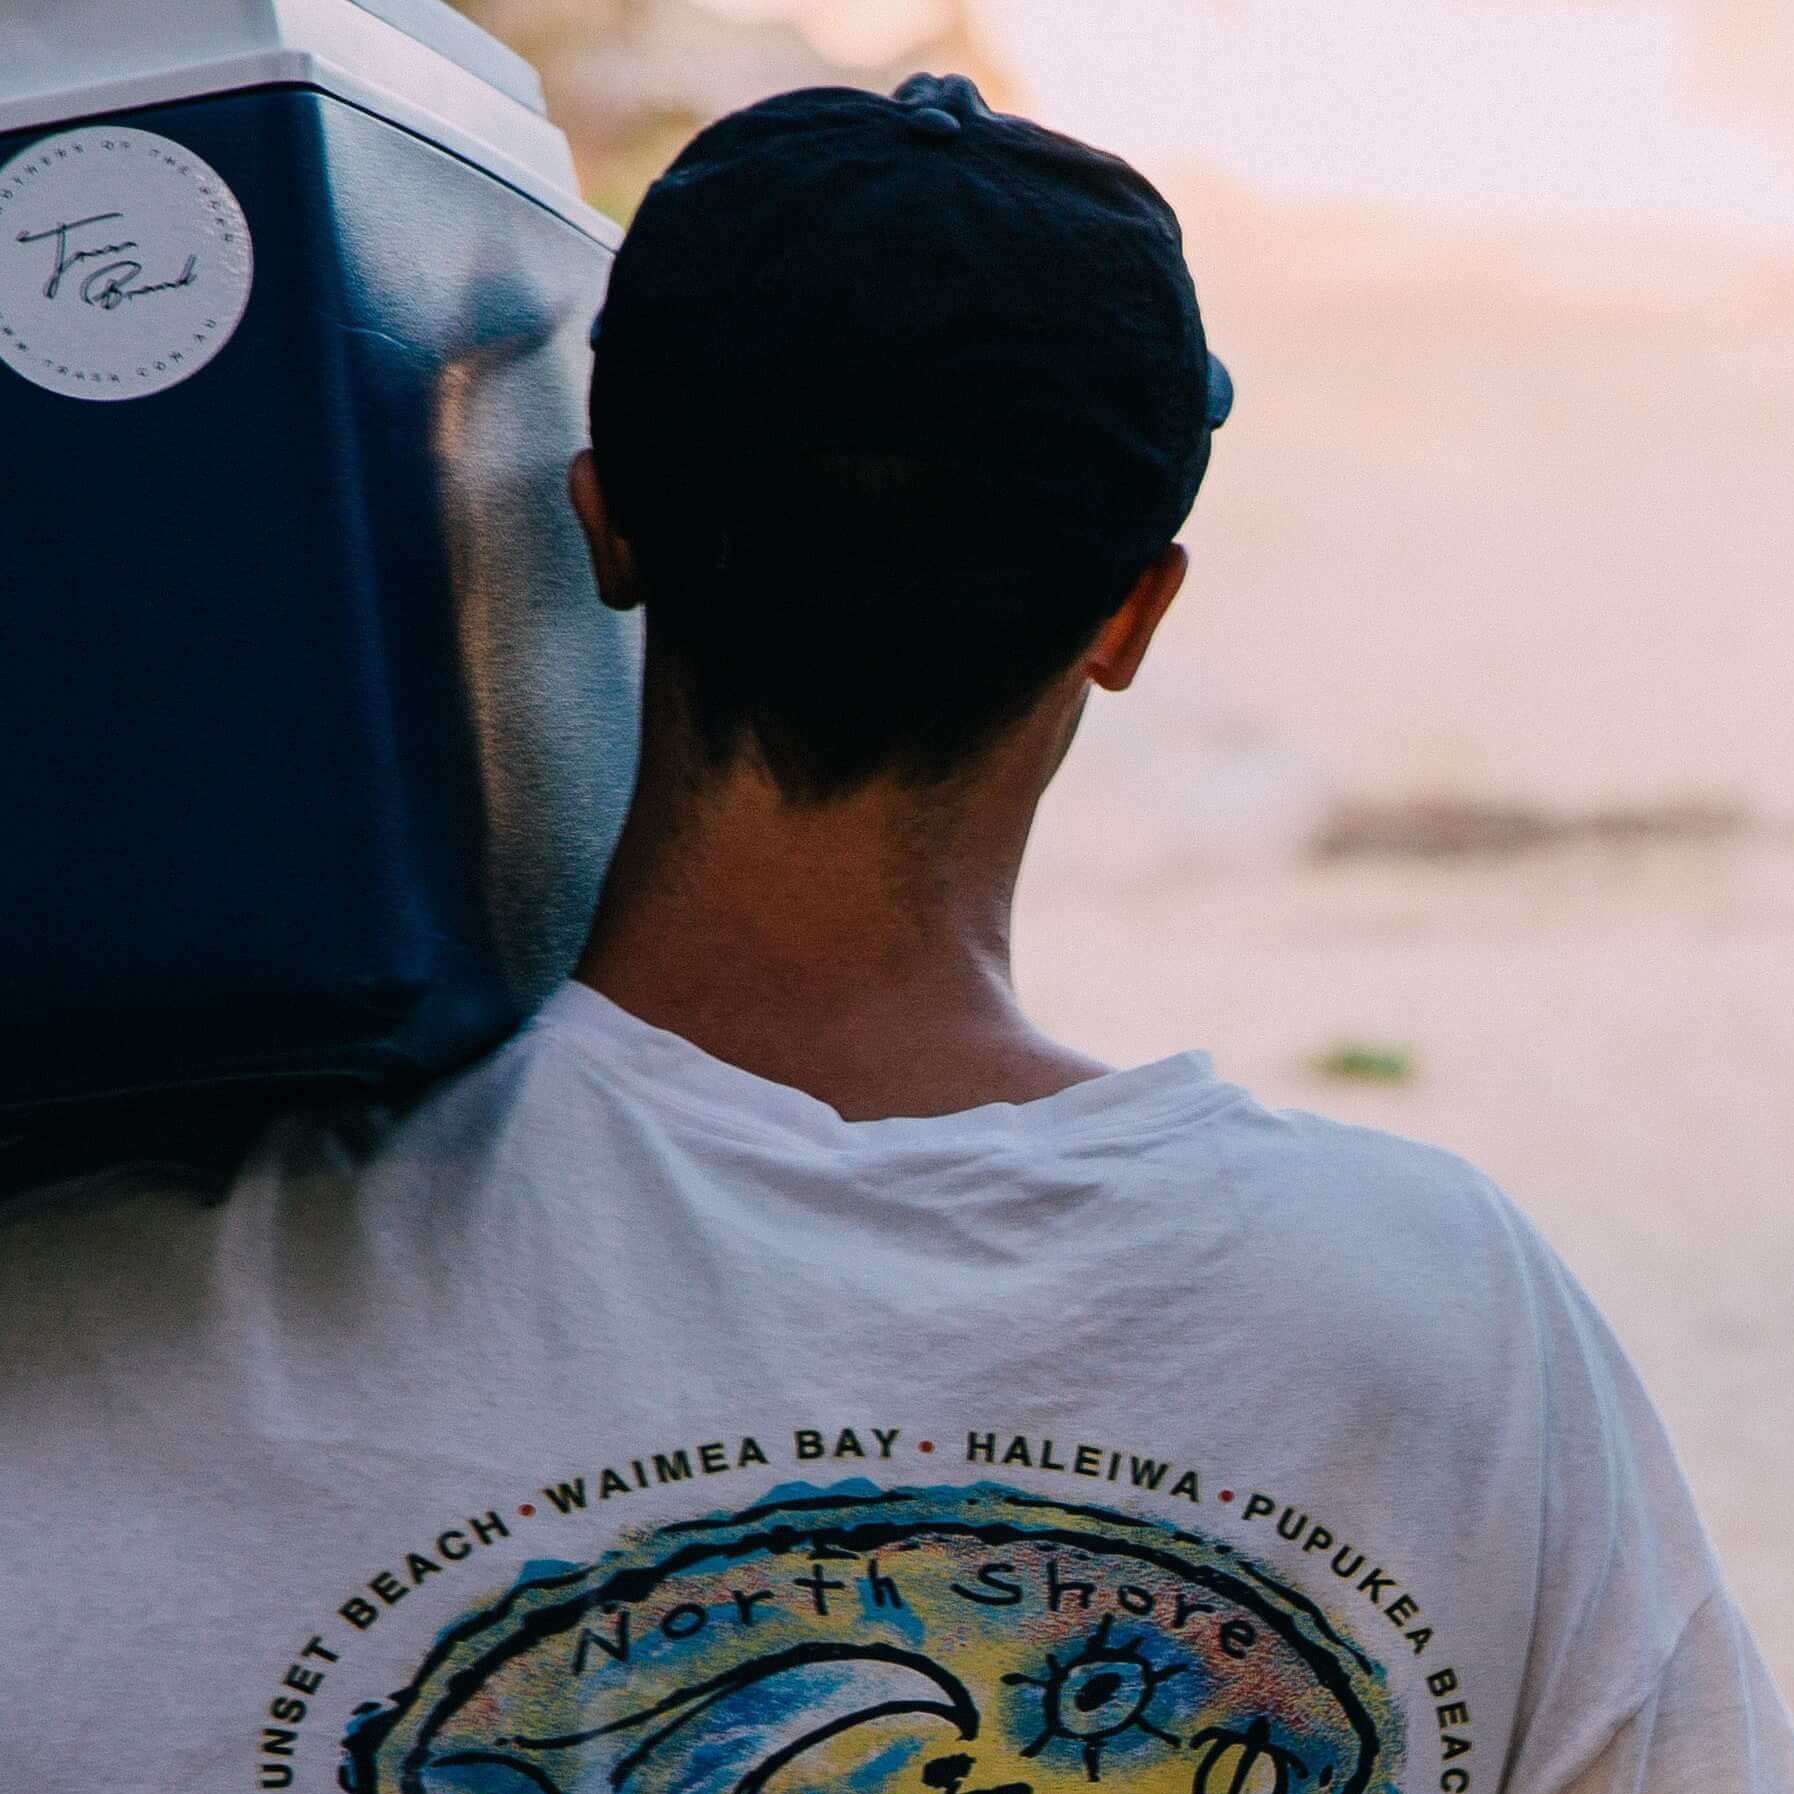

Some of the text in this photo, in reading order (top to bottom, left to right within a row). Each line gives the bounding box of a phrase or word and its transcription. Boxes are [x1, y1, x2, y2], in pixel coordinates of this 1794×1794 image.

[337, 1511, 511, 1632] BEACH
[543, 1436, 769, 1514] WAIMEA
[794, 1428, 899, 1460] BAY
[966, 1431, 1200, 1503] HALEIWA
[1241, 1493, 1433, 1655] PUPUKEA
[573, 1559, 1258, 1674] North Shore
